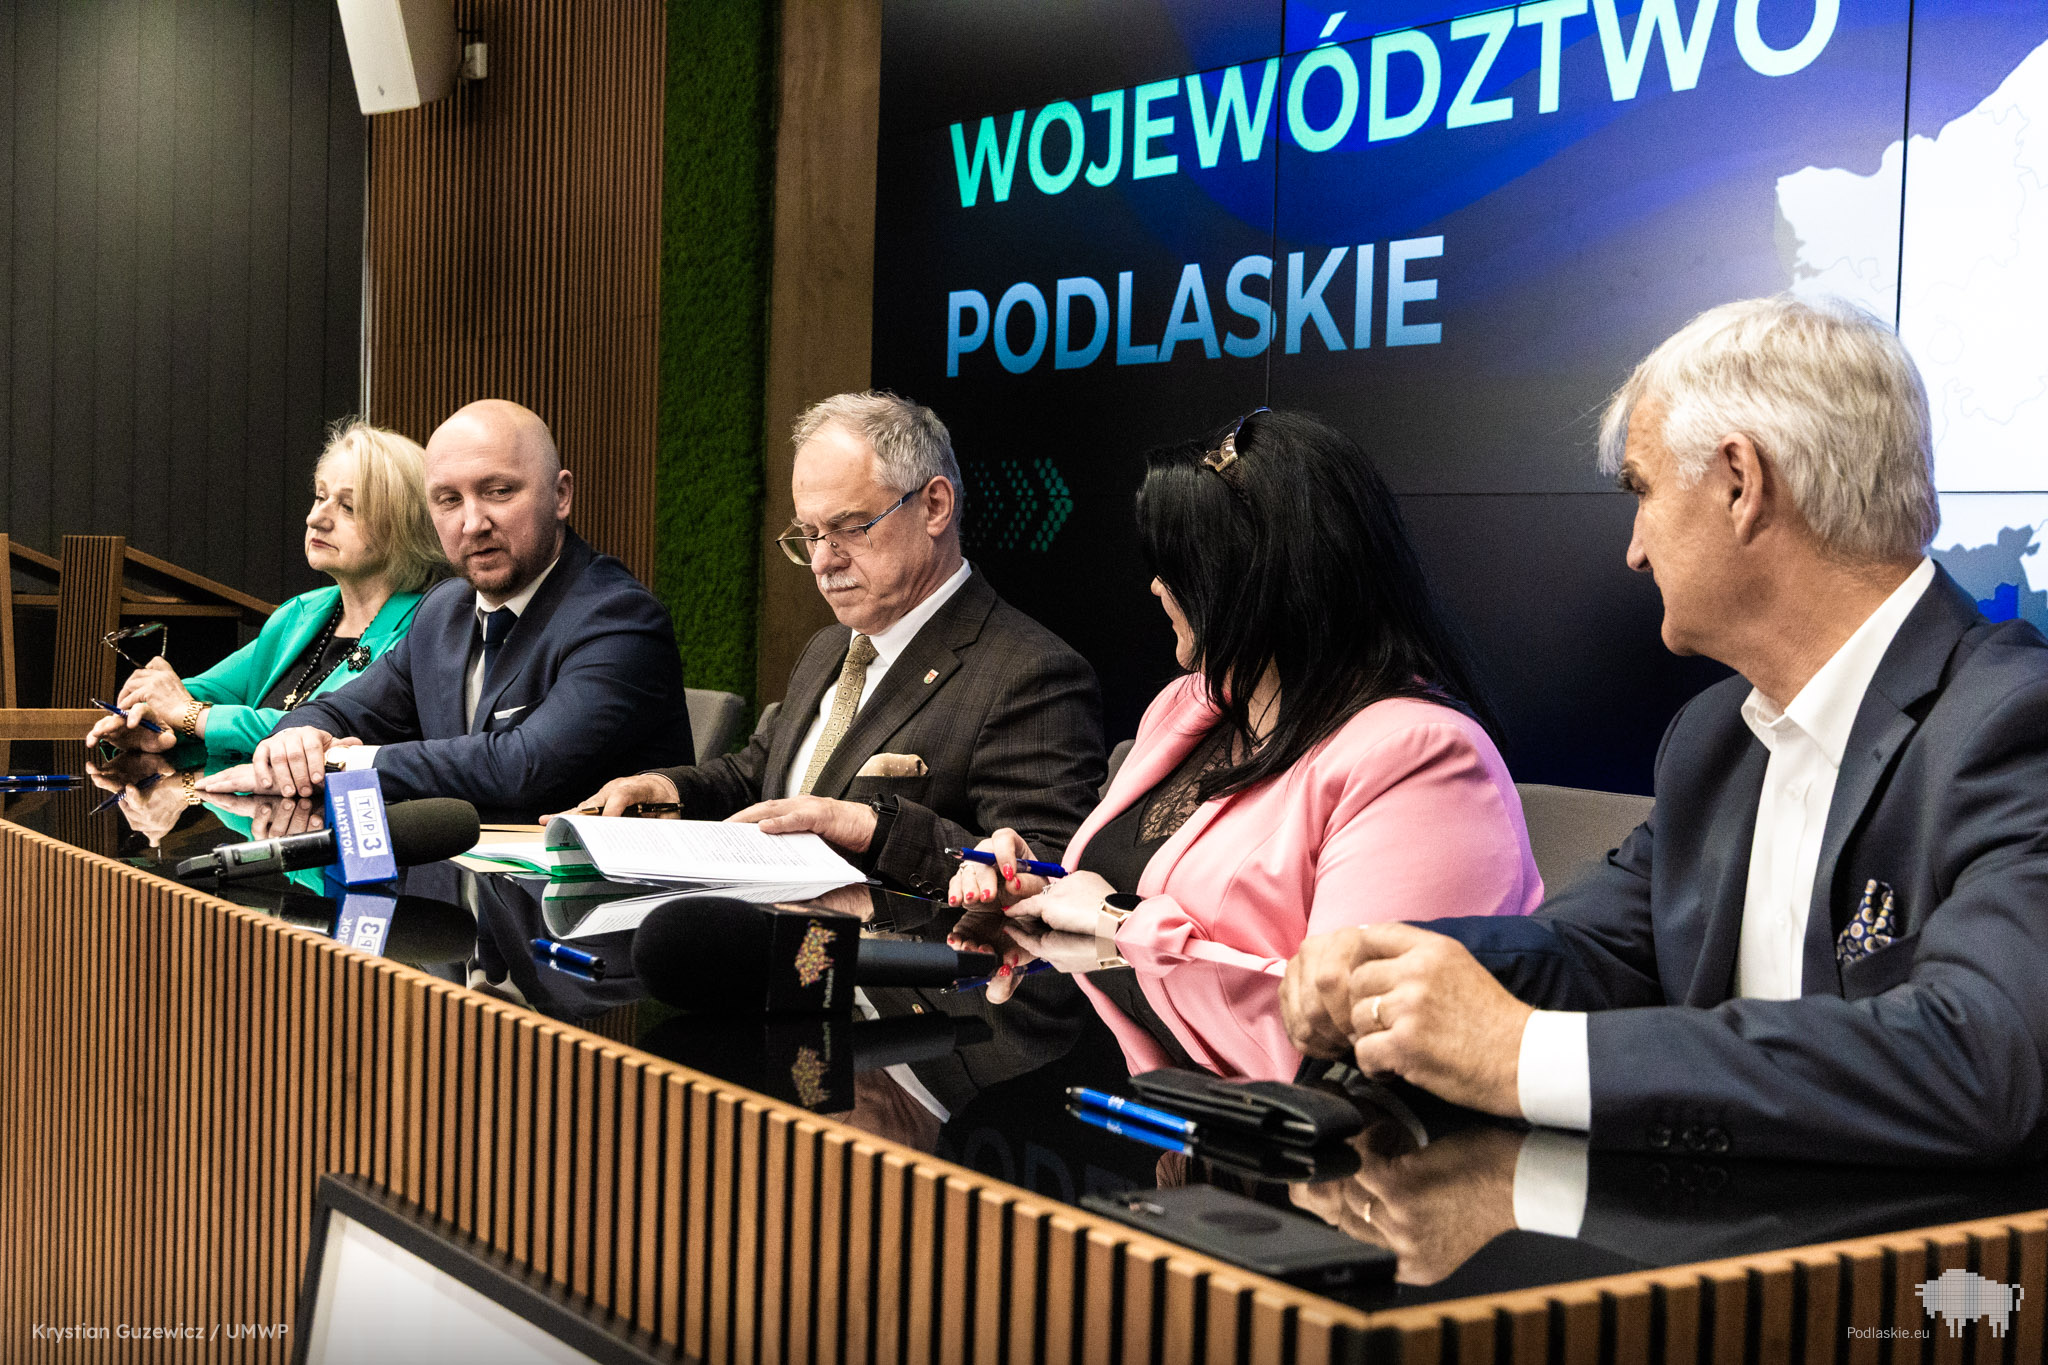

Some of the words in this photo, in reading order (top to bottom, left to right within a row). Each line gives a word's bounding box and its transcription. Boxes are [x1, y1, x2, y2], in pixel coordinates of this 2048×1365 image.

[949, 0, 1841, 208] WOJEWÓDZTWO
[946, 235, 1445, 378] PODLASKIE
[333, 795, 355, 856] BIAŁYSTOK
